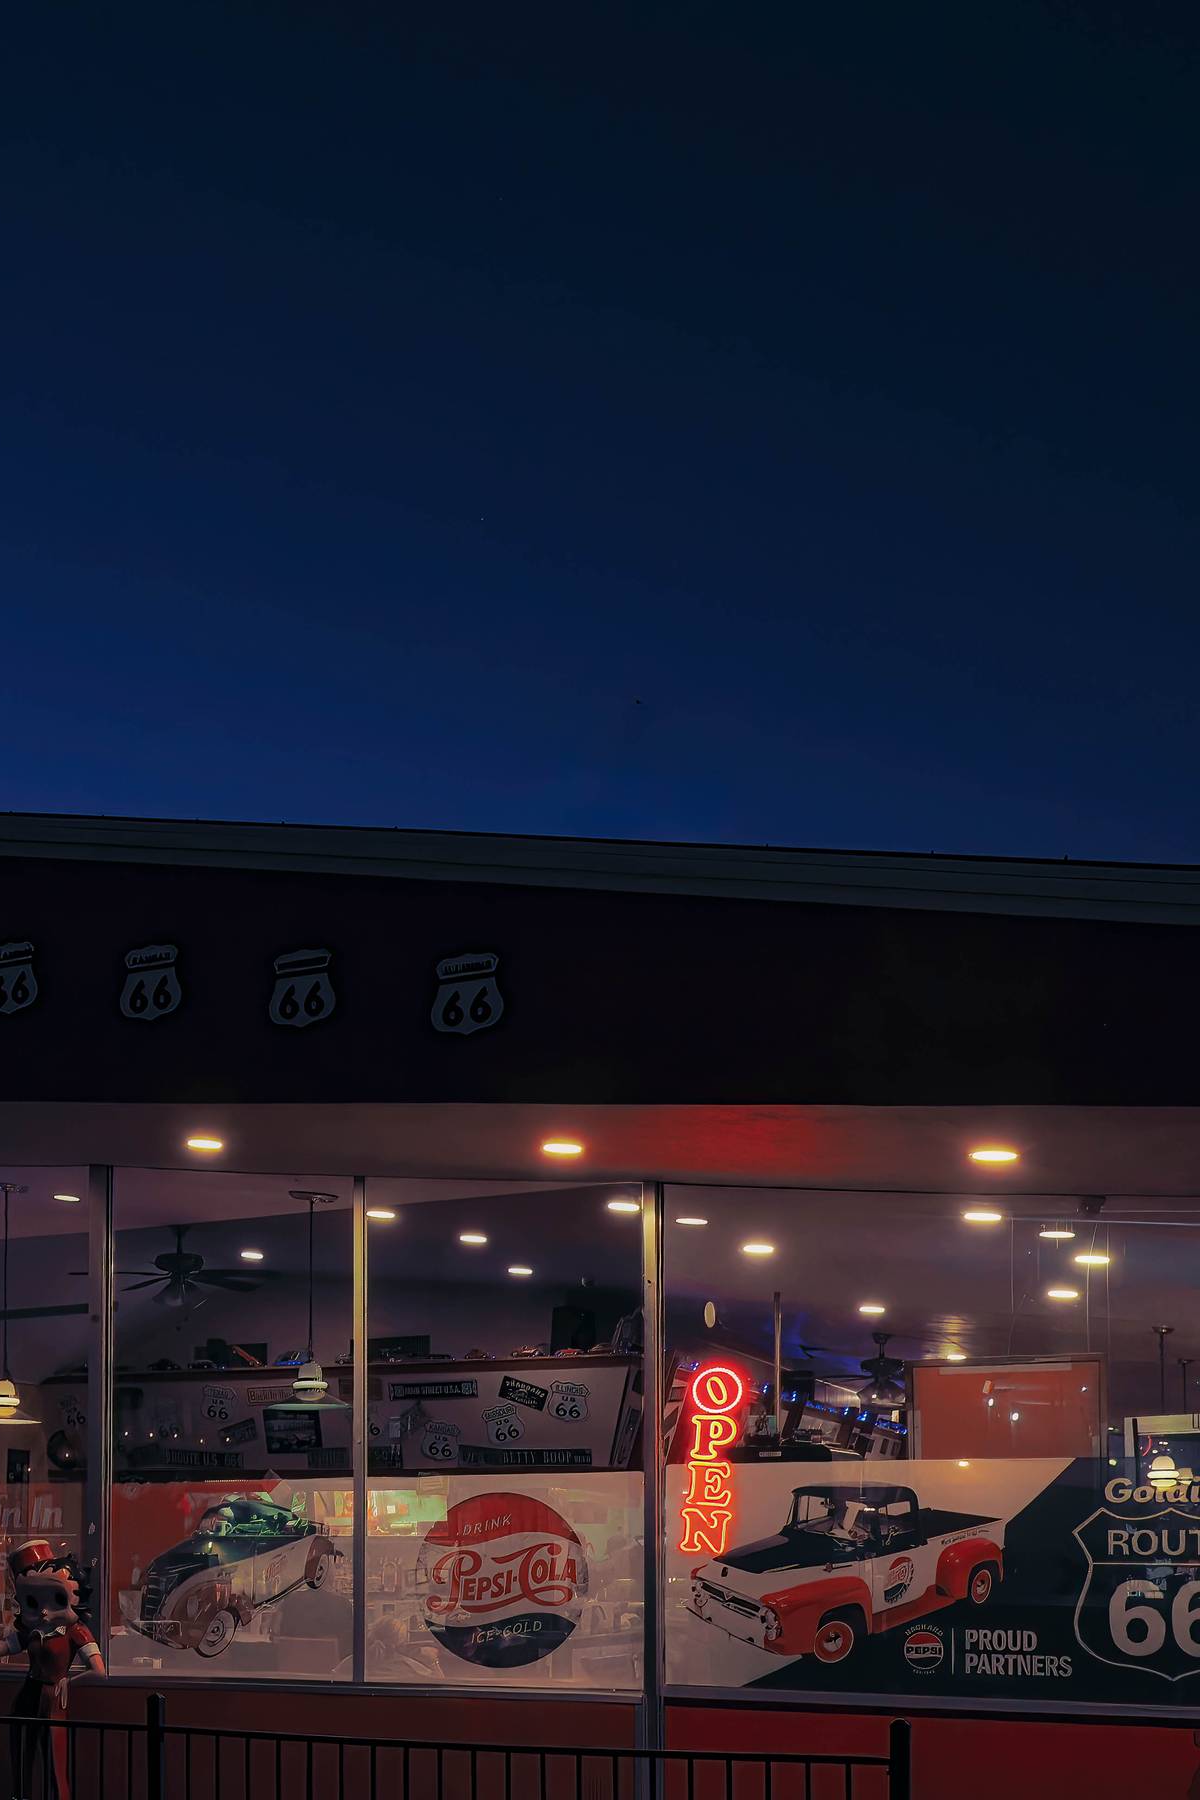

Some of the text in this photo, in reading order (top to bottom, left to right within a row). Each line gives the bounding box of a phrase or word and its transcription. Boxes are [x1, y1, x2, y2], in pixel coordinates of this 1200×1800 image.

[130, 975, 172, 1014] 66
[278, 980, 325, 1020] 66
[442, 986, 492, 1027] 66
[207, 1405, 229, 1421] 66
[555, 1403, 581, 1419] 66
[495, 1424, 520, 1442] 66
[429, 1441, 452, 1458] 66
[680, 1367, 743, 1556] OPEN
[31, 1496, 64, 1529] In
[463, 1514, 513, 1537] DRINK
[906, 1646, 943, 1655] PEPSI
[965, 1628, 1038, 1652] PROUD
[965, 1653, 1073, 1678] PARTNERS
